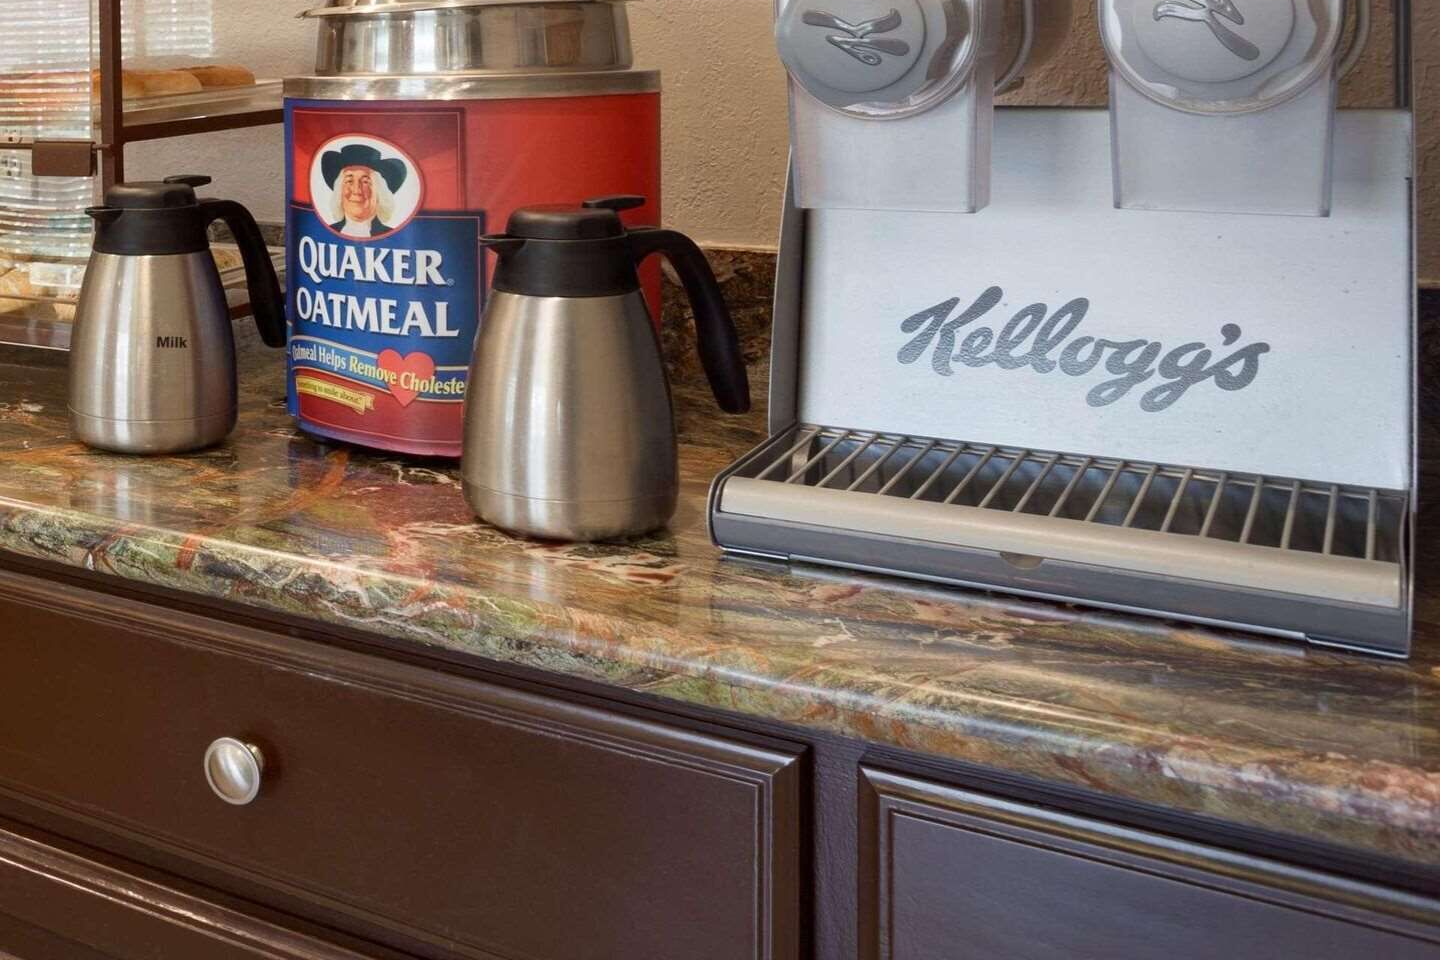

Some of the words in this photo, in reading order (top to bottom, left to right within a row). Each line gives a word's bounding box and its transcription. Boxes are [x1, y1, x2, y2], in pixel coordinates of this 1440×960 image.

[298, 235, 448, 285] QUAKER
[296, 286, 460, 338] OATMEAL
[156, 336, 188, 349] Milk
[292, 344, 317, 362] Oatmeal
[318, 346, 346, 371] Helps
[349, 355, 398, 385] Remove
[896, 285, 1271, 412] Kellogg's
